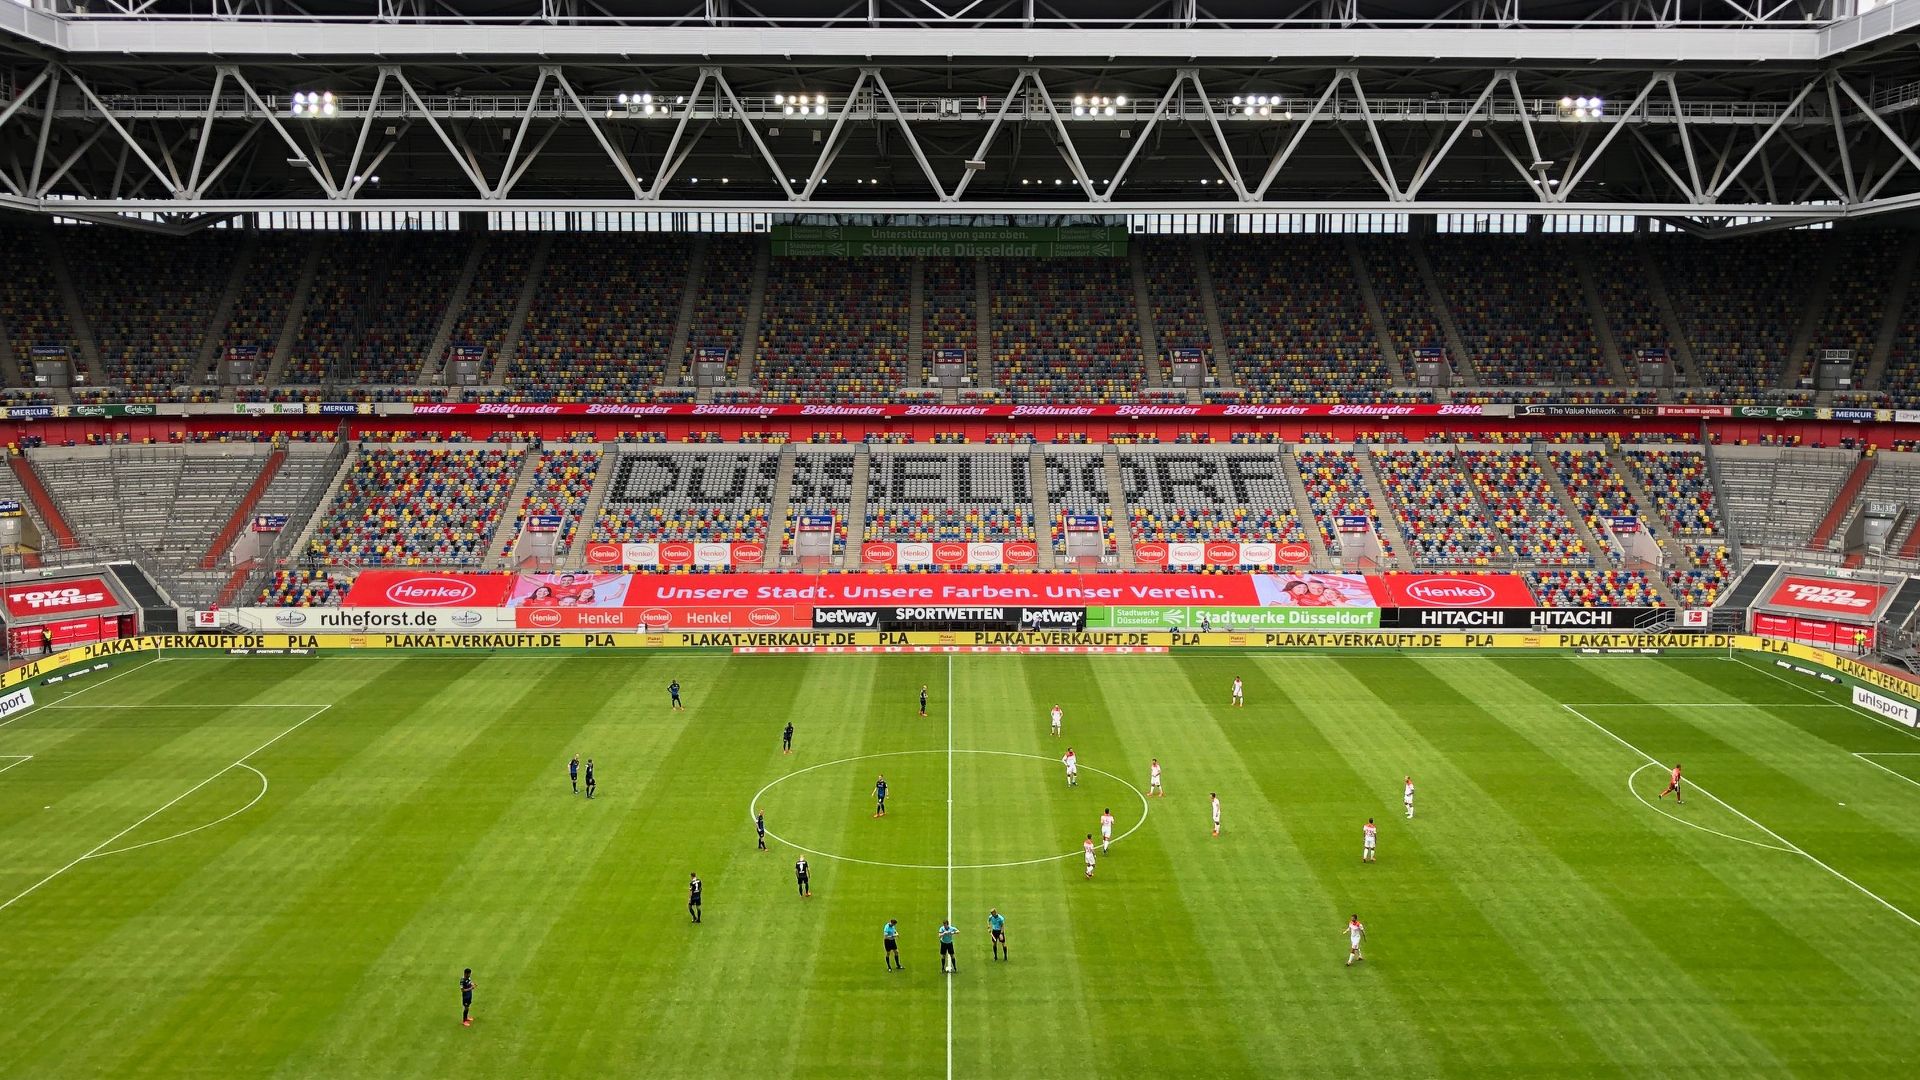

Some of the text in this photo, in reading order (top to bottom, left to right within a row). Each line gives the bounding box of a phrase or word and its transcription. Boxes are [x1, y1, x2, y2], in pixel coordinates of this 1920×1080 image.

[871, 229, 948, 241] Unterstützung
[971, 231, 997, 241] ganz
[999, 230, 1028, 239] oben.
[862, 243, 1037, 256] Stadtwerke Düsseldorf
[11, 408, 49, 416] MERKUR
[77, 406, 105, 415] Carlsberg
[125, 406, 153, 415] Carlsberg
[476, 404, 562, 415] Böklunder
[585, 404, 672, 415] Böklunder
[692, 404, 778, 415] Böklunder
[800, 404, 886, 415] Böklunder
[905, 404, 990, 415] Böklunder
[1012, 404, 1097, 415] Böklunder
[1115, 404, 1201, 415] Böklunder
[1223, 404, 1309, 415] Böklunder
[1328, 404, 1415, 415] Böklunder
[1549, 407, 1562, 415] The
[1563, 407, 1585, 415] Value
[1741, 407, 1769, 417] Carlsberg
[1776, 407, 1803, 417] Carlsberg
[592, 549, 618, 559] Henkel
[628, 549, 653, 559] Henkel
[663, 549, 689, 559] Henkel
[698, 549, 723, 559] Henkel
[735, 549, 761, 559] Henkel
[867, 549, 893, 559] Henkel
[903, 549, 928, 559] Henkel
[939, 549, 964, 559] Henkel
[973, 549, 998, 559] Henkel
[1009, 549, 1035, 559] Henkel
[1139, 549, 1165, 559] Henkel
[1174, 549, 1200, 559] Henkel
[1210, 549, 1236, 559] Henkel
[1245, 549, 1270, 559] Henkel
[1281, 549, 1307, 559] Henkel
[9, 588, 80, 601] TOYO
[395, 584, 469, 597] Henkel
[656, 584, 1224, 599] Unsere Stadt. Unsere Farben. Unser Verein.
[1414, 585, 1488, 597] Henkel
[1787, 584, 1856, 597] TOYO
[27, 593, 104, 608] TIRES
[1794, 592, 1872, 608] TIRES
[320, 611, 437, 626] ruheforst.de
[532, 613, 558, 622] Henkel
[578, 612, 624, 624] Henkel
[643, 613, 669, 622] Henkel
[686, 612, 732, 624] Henkel
[751, 612, 777, 622] Henkel
[816, 609, 877, 627] betway
[896, 608, 1004, 620] SPORTWETTEN
[1022, 608, 1083, 626] betway
[1195, 610, 1374, 625] Stadtwerke Düsseldorf
[1421, 611, 1504, 625] HITACHI
[1530, 611, 1612, 625] HITACHI
[1117, 616, 1160, 624] Düsseldorf
[288, 635, 319, 648] PLA
[385, 634, 561, 648] PLAKAT-VERKAUFT.DE
[585, 634, 616, 647] PLA
[682, 633, 856, 646] PLAKAT-VERKAUFT.DE
[879, 633, 909, 645] PLA
[974, 633, 1149, 646] PLAKAT-VERKAUFT.DE
[1171, 633, 1201, 646] PLA
[1265, 634, 1442, 647] PLAKAT-VERKAUFT.DE
[1465, 634, 1494, 647] PLA
[1559, 634, 1736, 648] PLAKAT-VERKAUFT.DE
[84, 635, 264, 658] PLAKAT-VERKAUFT.DE
[1761, 638, 1789, 653] PLA
[20, 662, 40, 681] PLA
[0, 692, 26, 715] port
[1859, 693, 1909, 719] uhlsport
